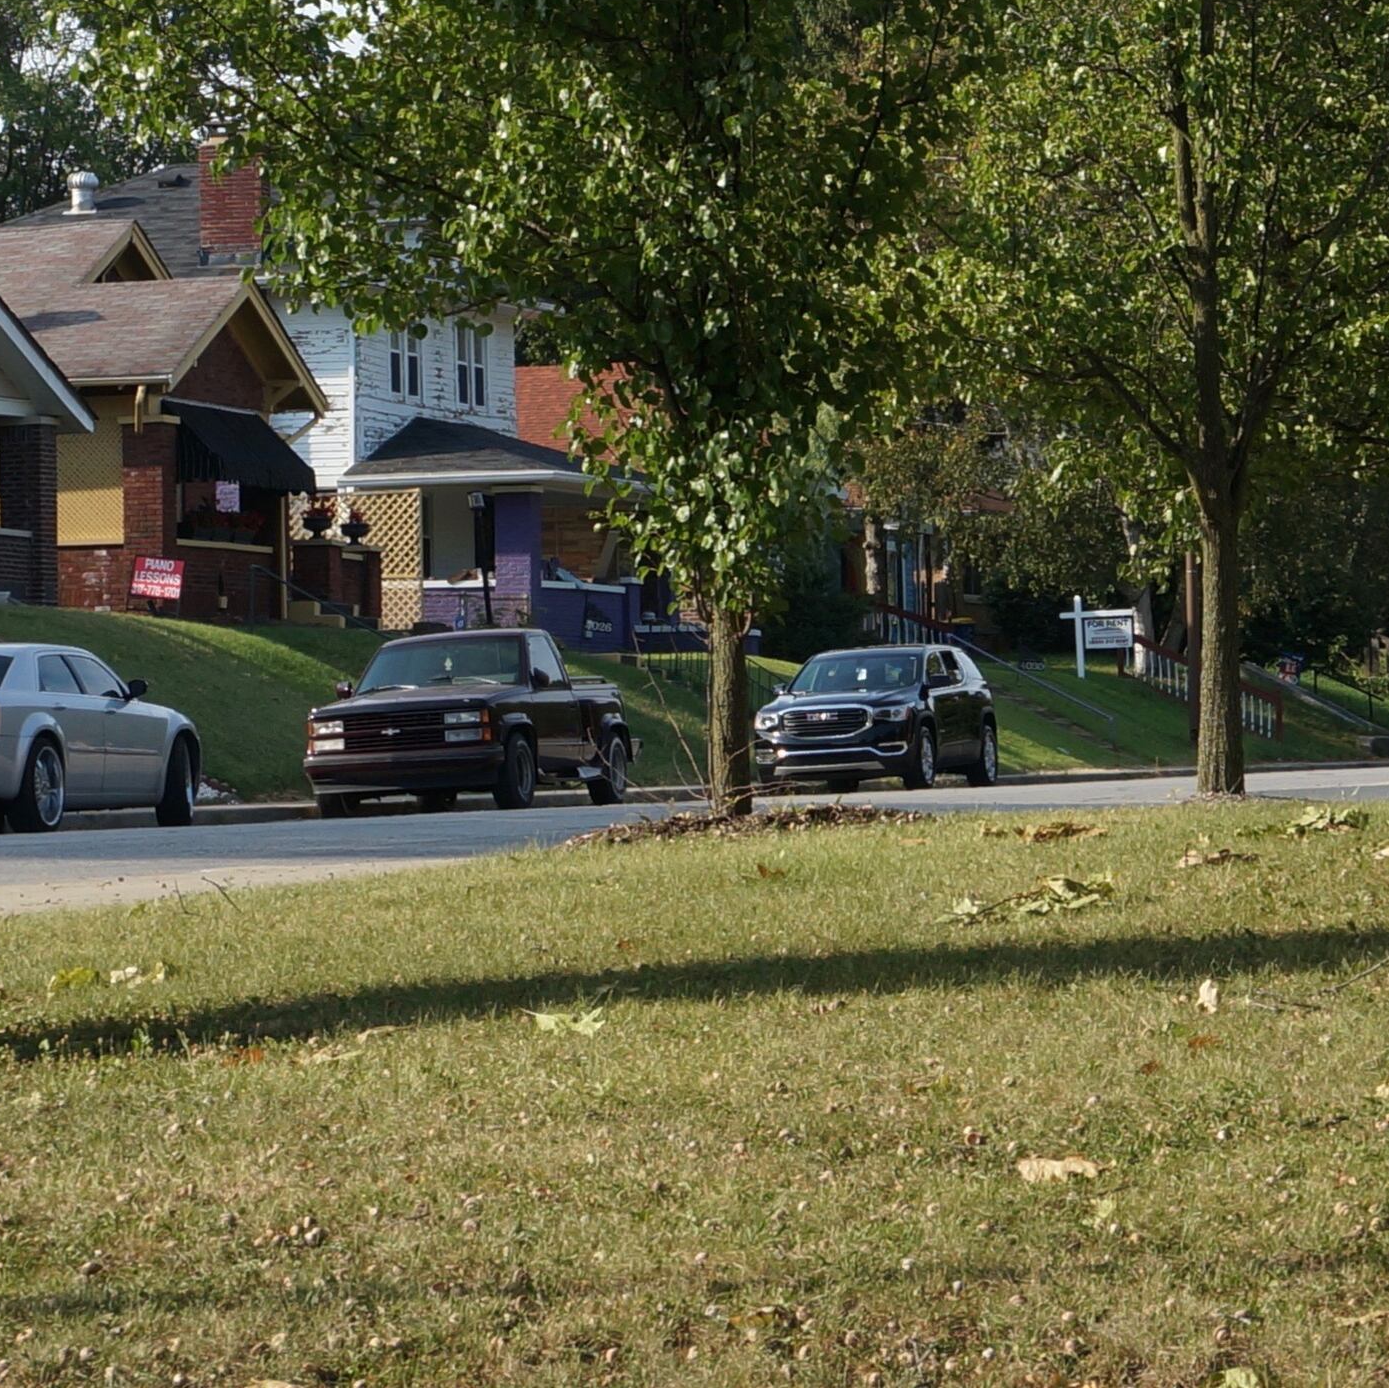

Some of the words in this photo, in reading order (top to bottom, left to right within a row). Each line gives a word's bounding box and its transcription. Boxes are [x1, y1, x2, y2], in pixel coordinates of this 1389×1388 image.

[144, 557, 175, 572] PIANO
[134, 571, 182, 586] LESSONS
[1087, 619, 1105, 629] FOR
